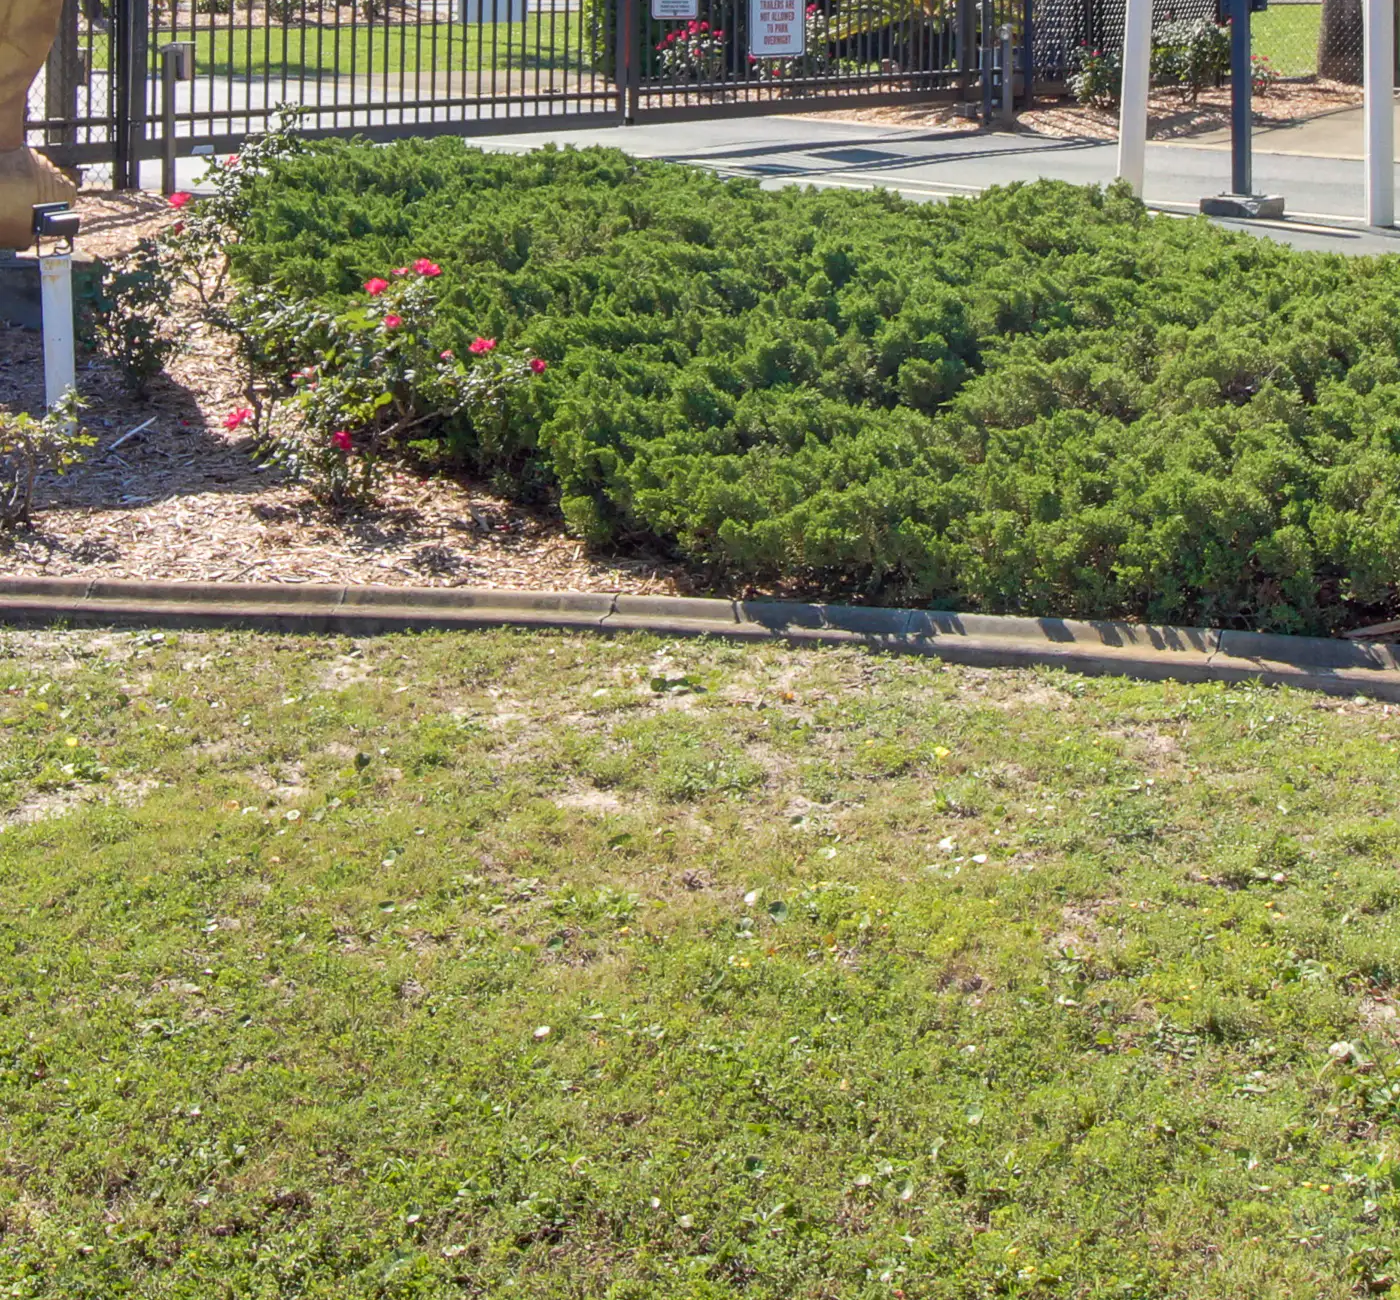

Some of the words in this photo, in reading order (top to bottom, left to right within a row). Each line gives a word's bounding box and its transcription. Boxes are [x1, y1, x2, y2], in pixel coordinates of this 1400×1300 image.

[760, 0, 784, 9] TRAILERS
[785, 0, 795, 9] ARE
[760, 12, 770, 21] NOT
[771, 11, 795, 21] ALLOWED
[767, 23, 774, 33] TO
[775, 23, 788, 33] PARK
[764, 35, 791, 45] OVERNIGHT
